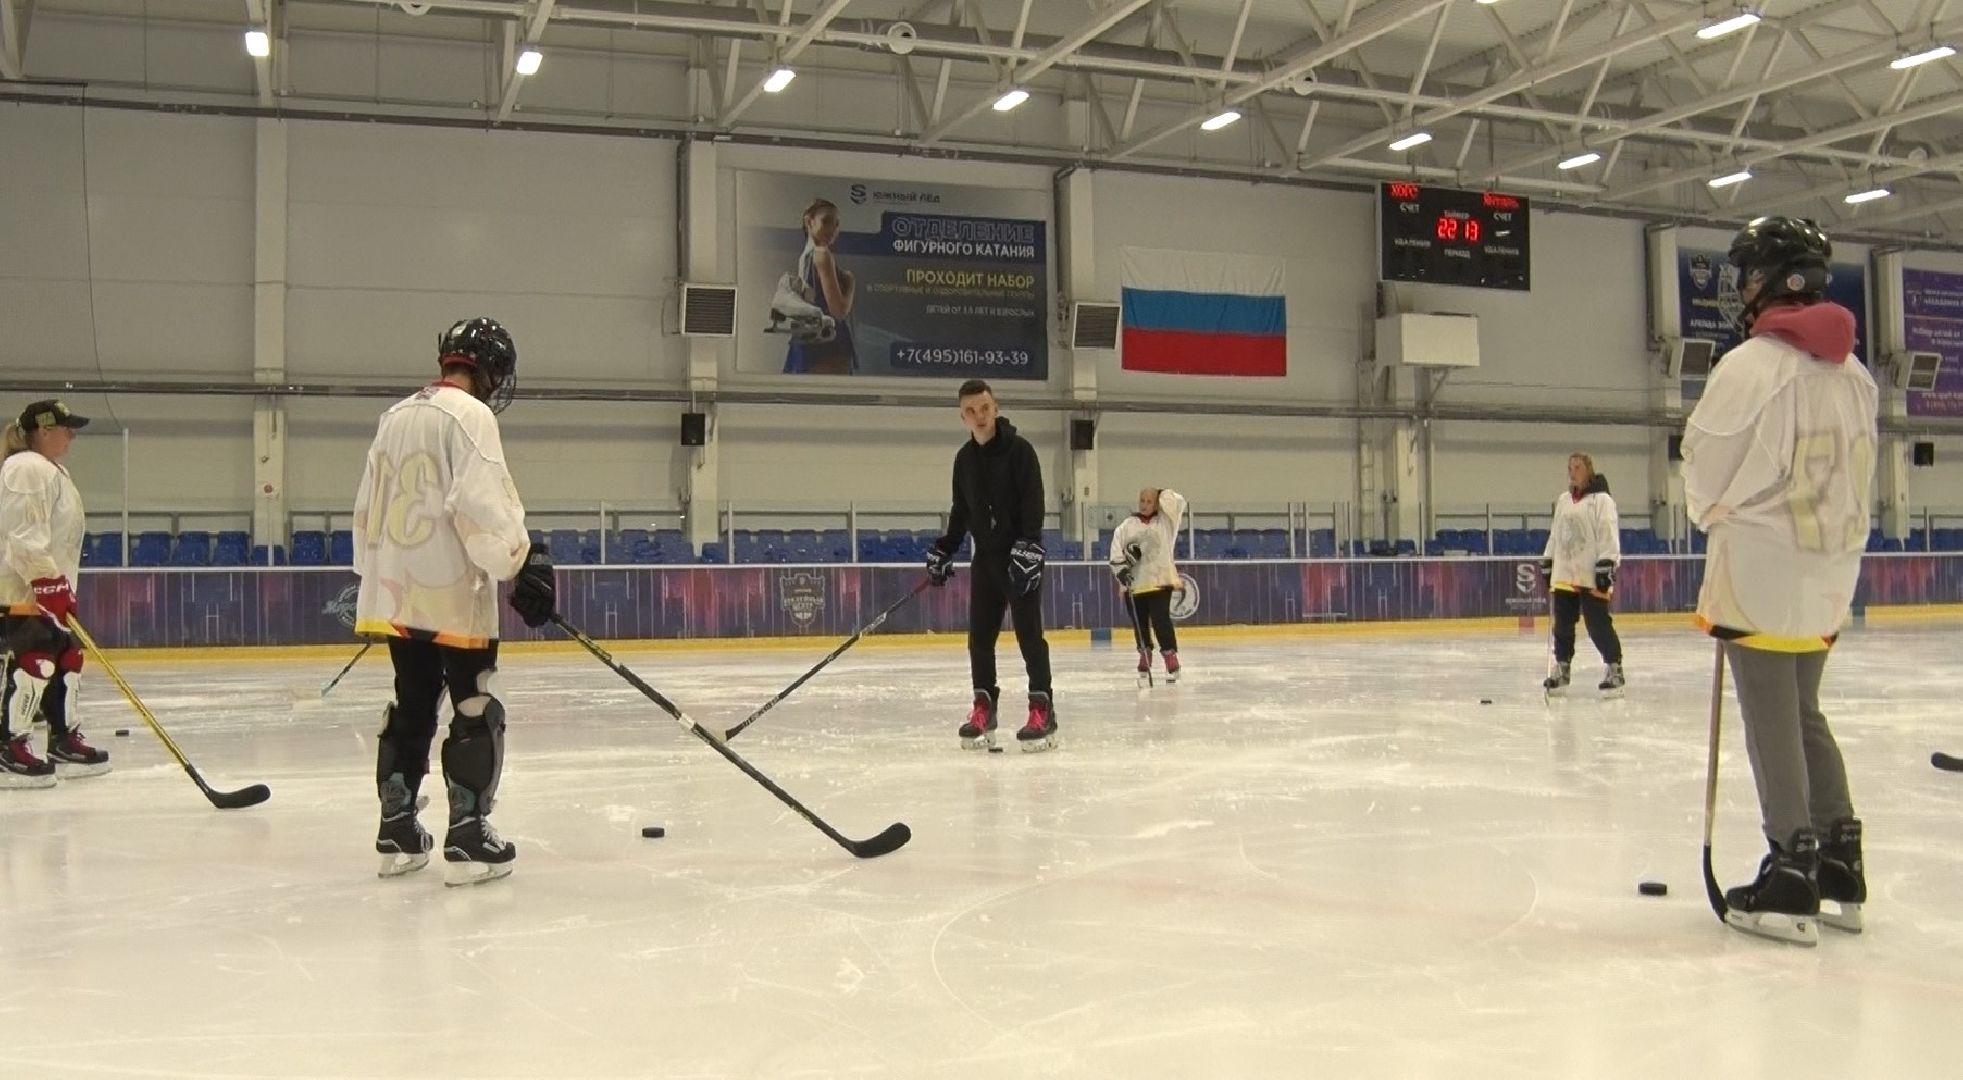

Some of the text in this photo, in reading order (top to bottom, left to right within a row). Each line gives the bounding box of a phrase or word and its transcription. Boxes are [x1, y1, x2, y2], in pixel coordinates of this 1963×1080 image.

[891, 217, 1035, 243] ОТДЕЛЕНИЕ
[892, 240, 1035, 259] ФИГУРНОГО КАТАНИЯ
[906, 269, 1035, 289] ПРОХОДИТ НАБОР
[897, 348, 1029, 366] +7(495)161-93-39
